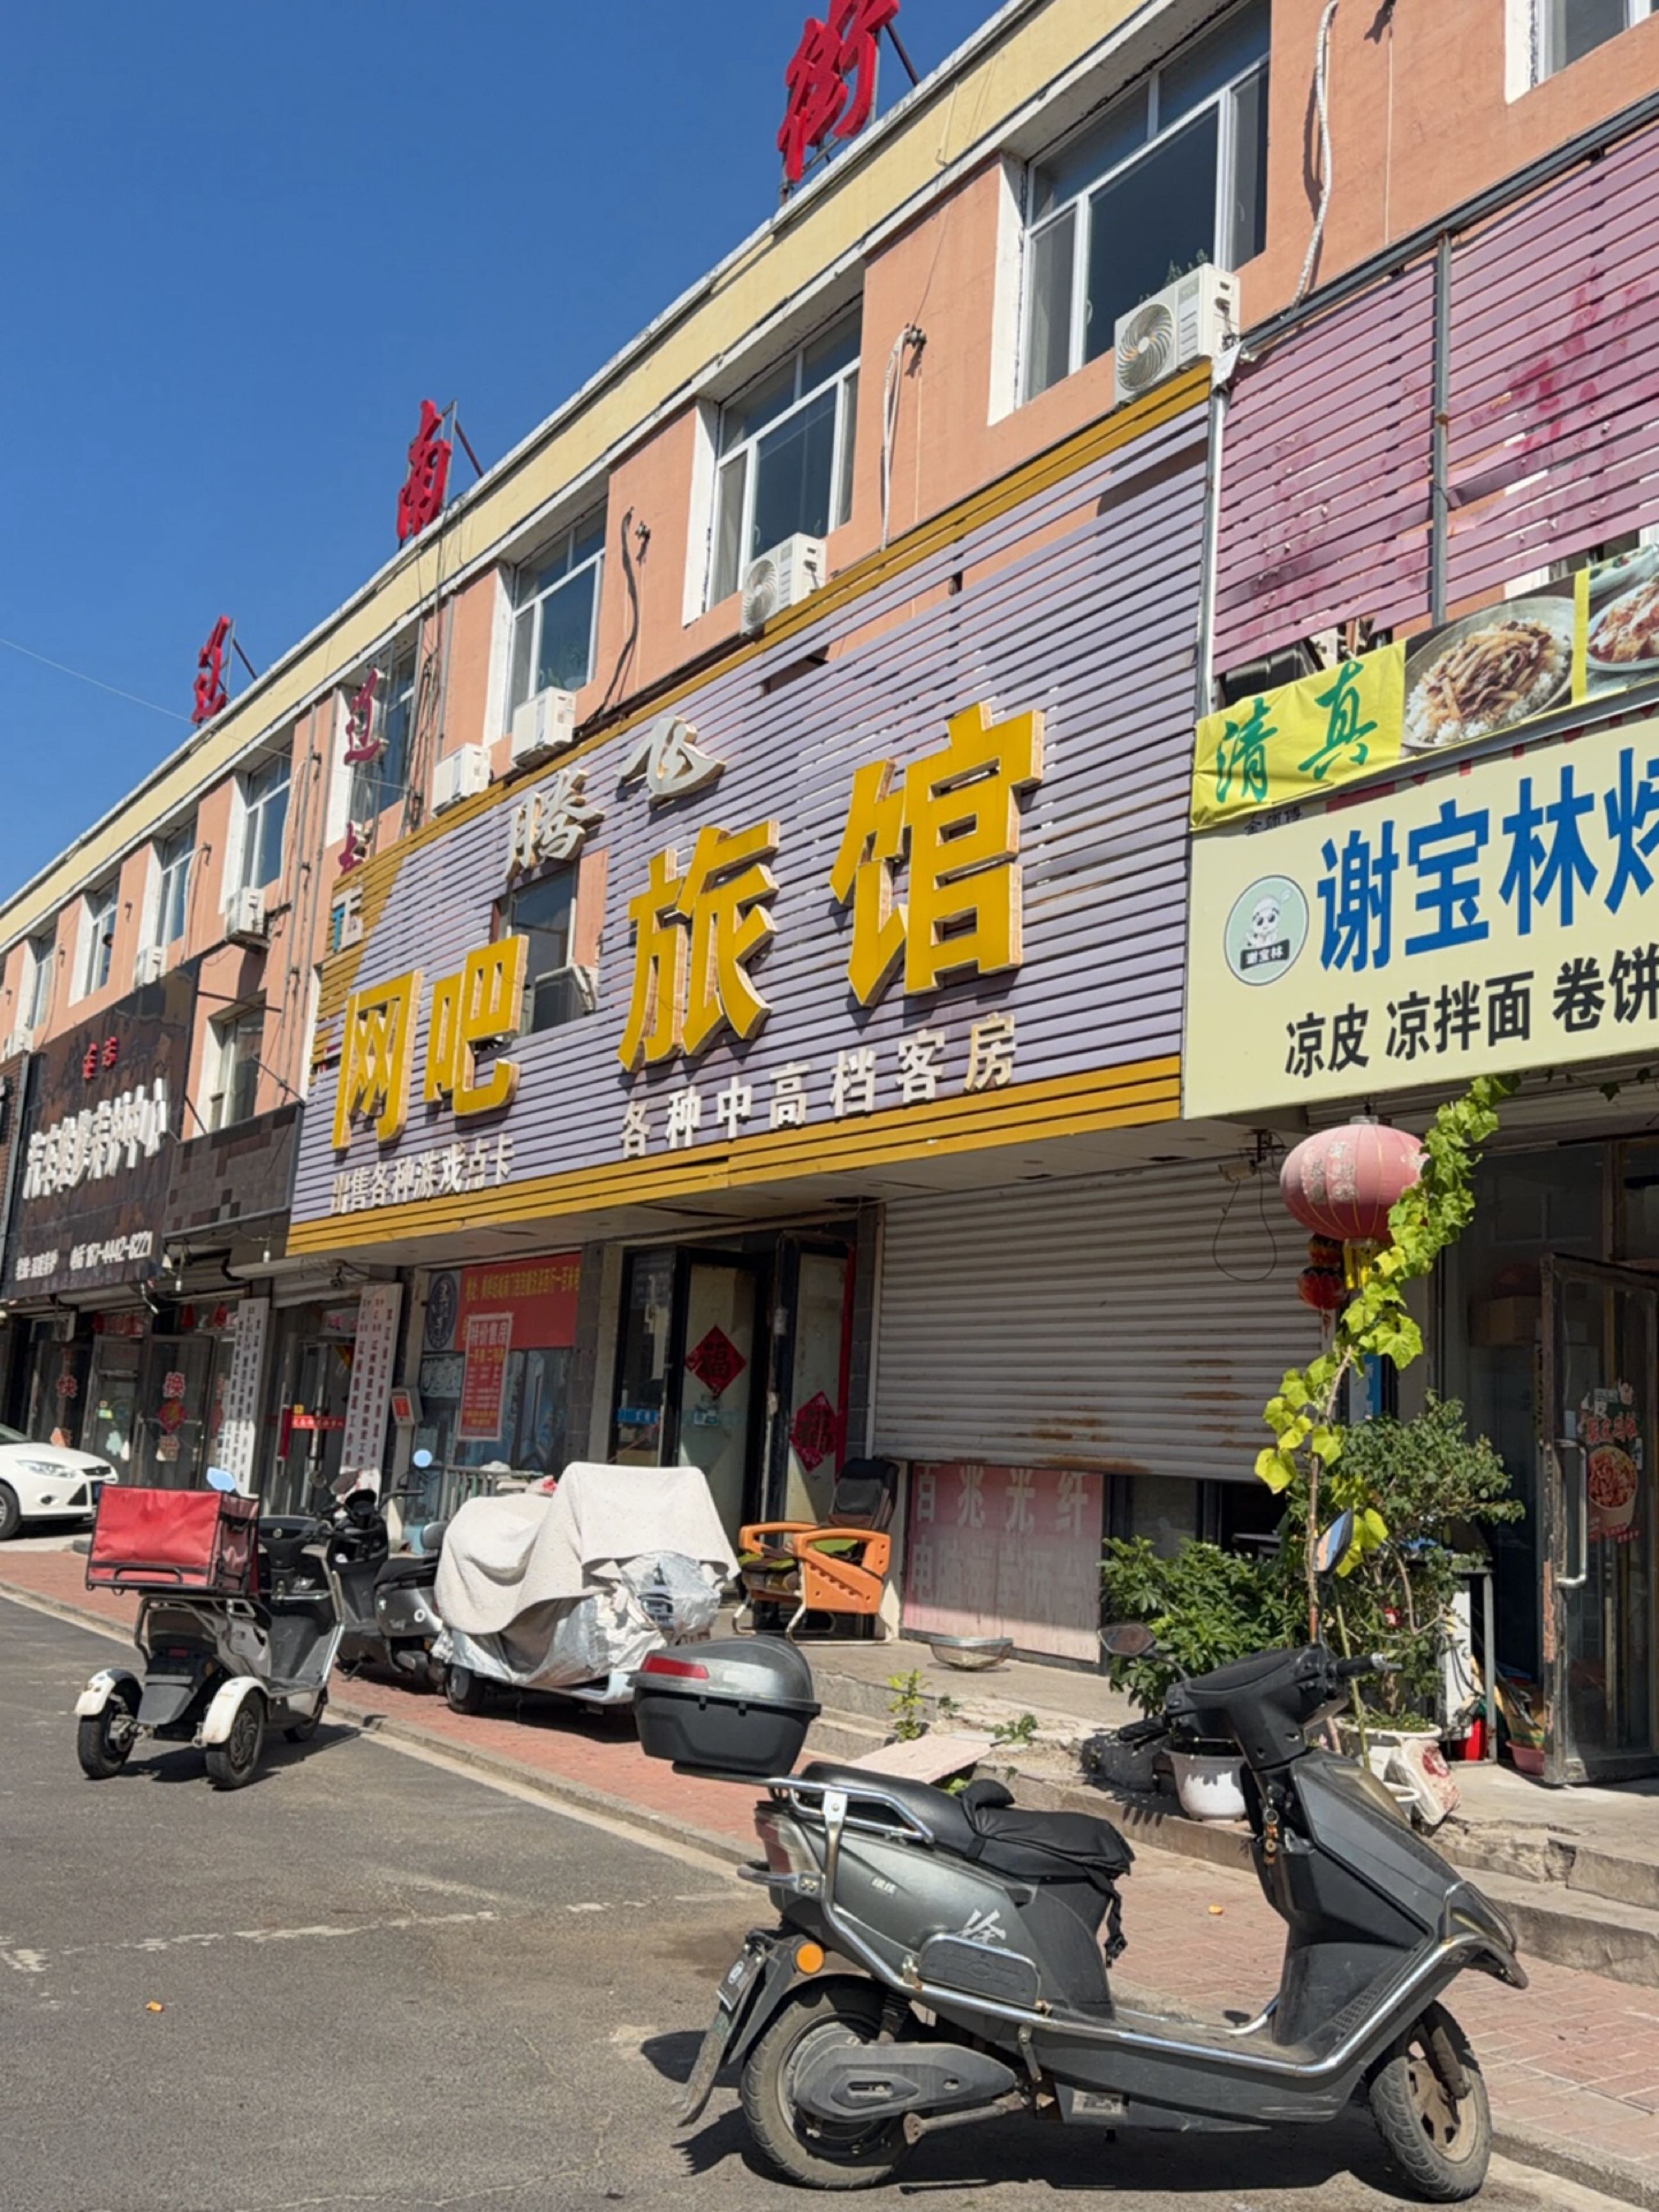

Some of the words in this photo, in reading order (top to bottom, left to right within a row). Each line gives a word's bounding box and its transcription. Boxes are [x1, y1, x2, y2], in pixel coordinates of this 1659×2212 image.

[1216, 660, 1378, 803] 清真
[617, 702, 1045, 1073] 旅馆
[332, 934, 529, 1151] 网吧
[1285, 1002, 1369, 1078] 凉皮
[1385, 971, 1535, 1061] 凉拌面
[1552, 942, 1659, 1033] 卷饼
[619, 1012, 1016, 1158] 各种中高档客房
[331, 1132, 515, 1215] 出售各种游戏点卡
